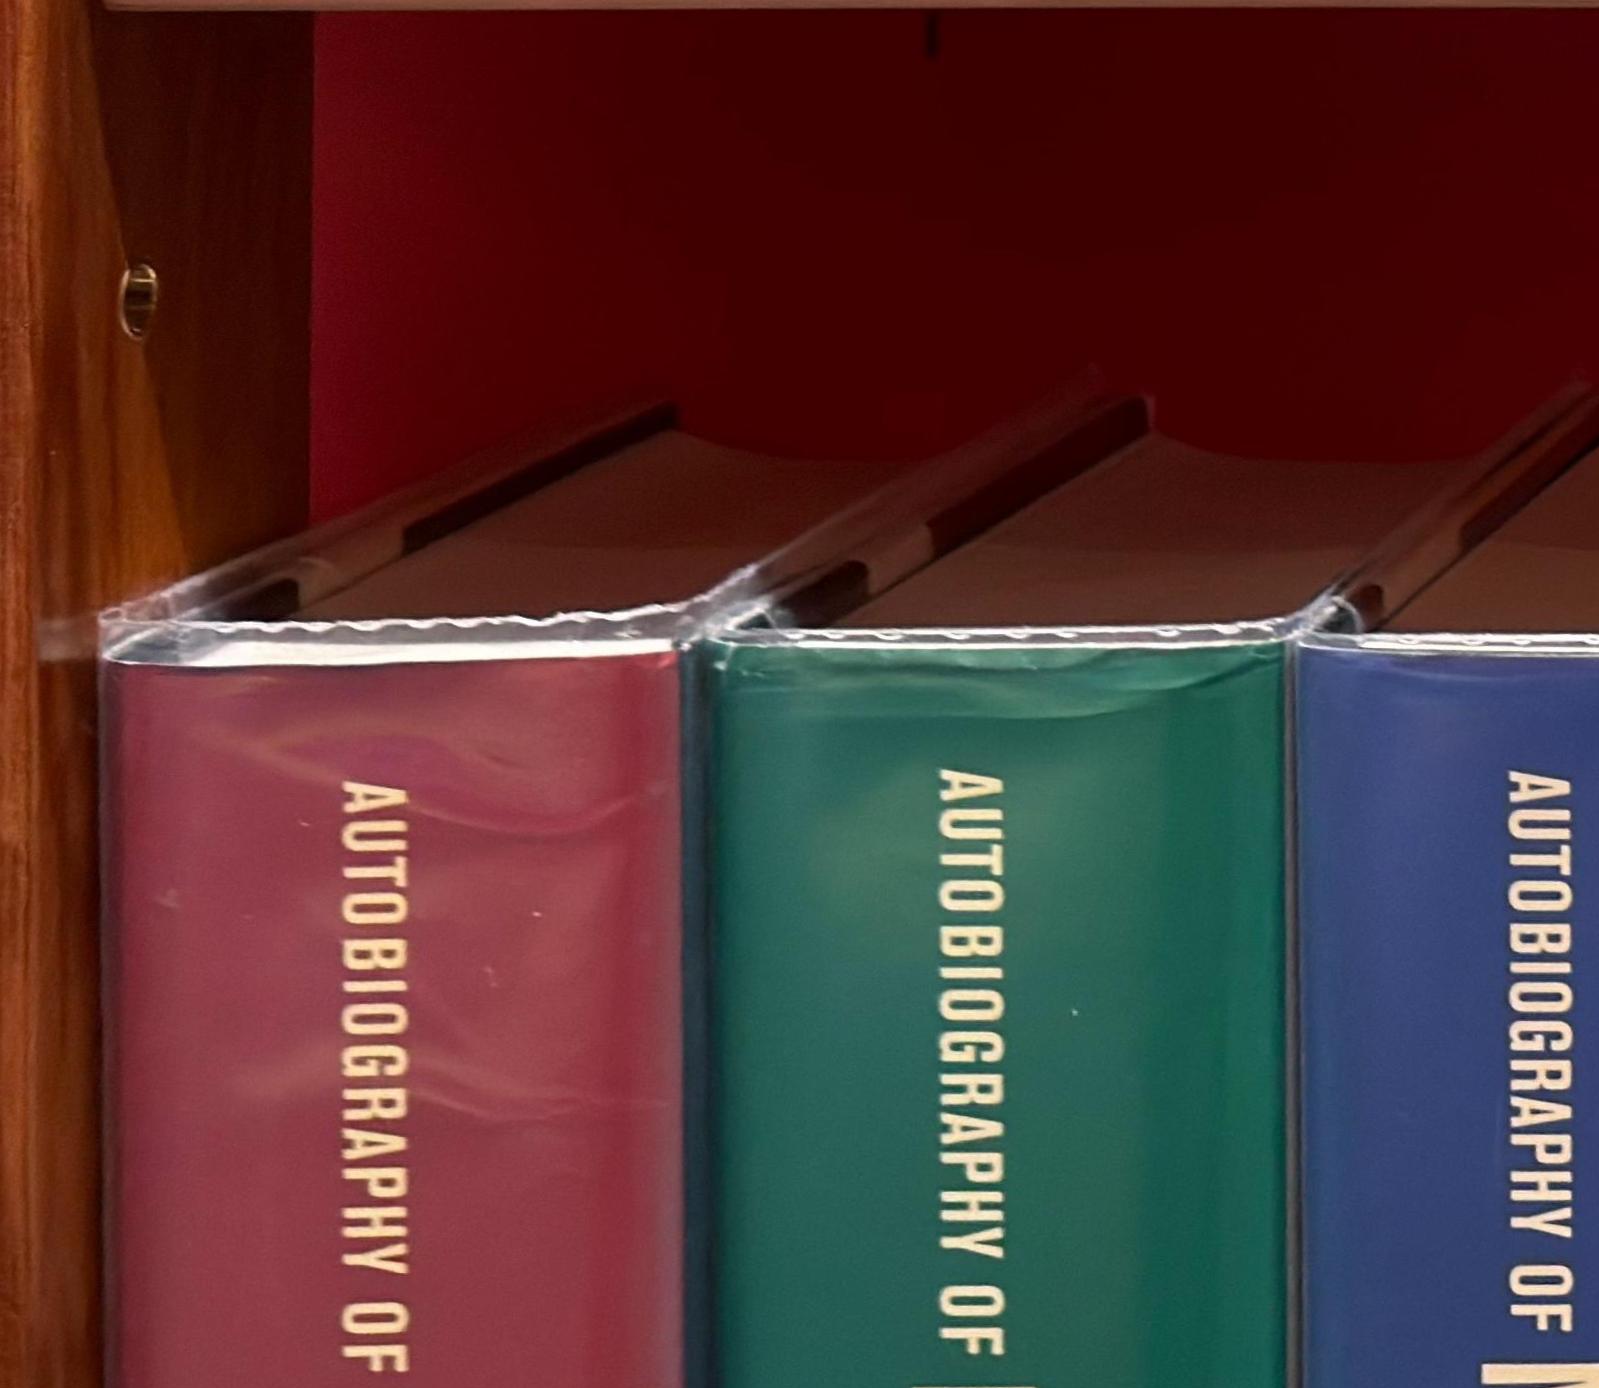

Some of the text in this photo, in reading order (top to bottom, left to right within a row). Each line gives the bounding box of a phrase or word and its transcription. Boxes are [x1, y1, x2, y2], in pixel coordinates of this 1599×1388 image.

[342, 780, 409, 1374] AUTOBIOGRAPHY OF
[936, 766, 1006, 1356] AUTOBIOGRAPHY OF
[1505, 768, 1575, 1334] AUTOBIOGRAPHY OF
